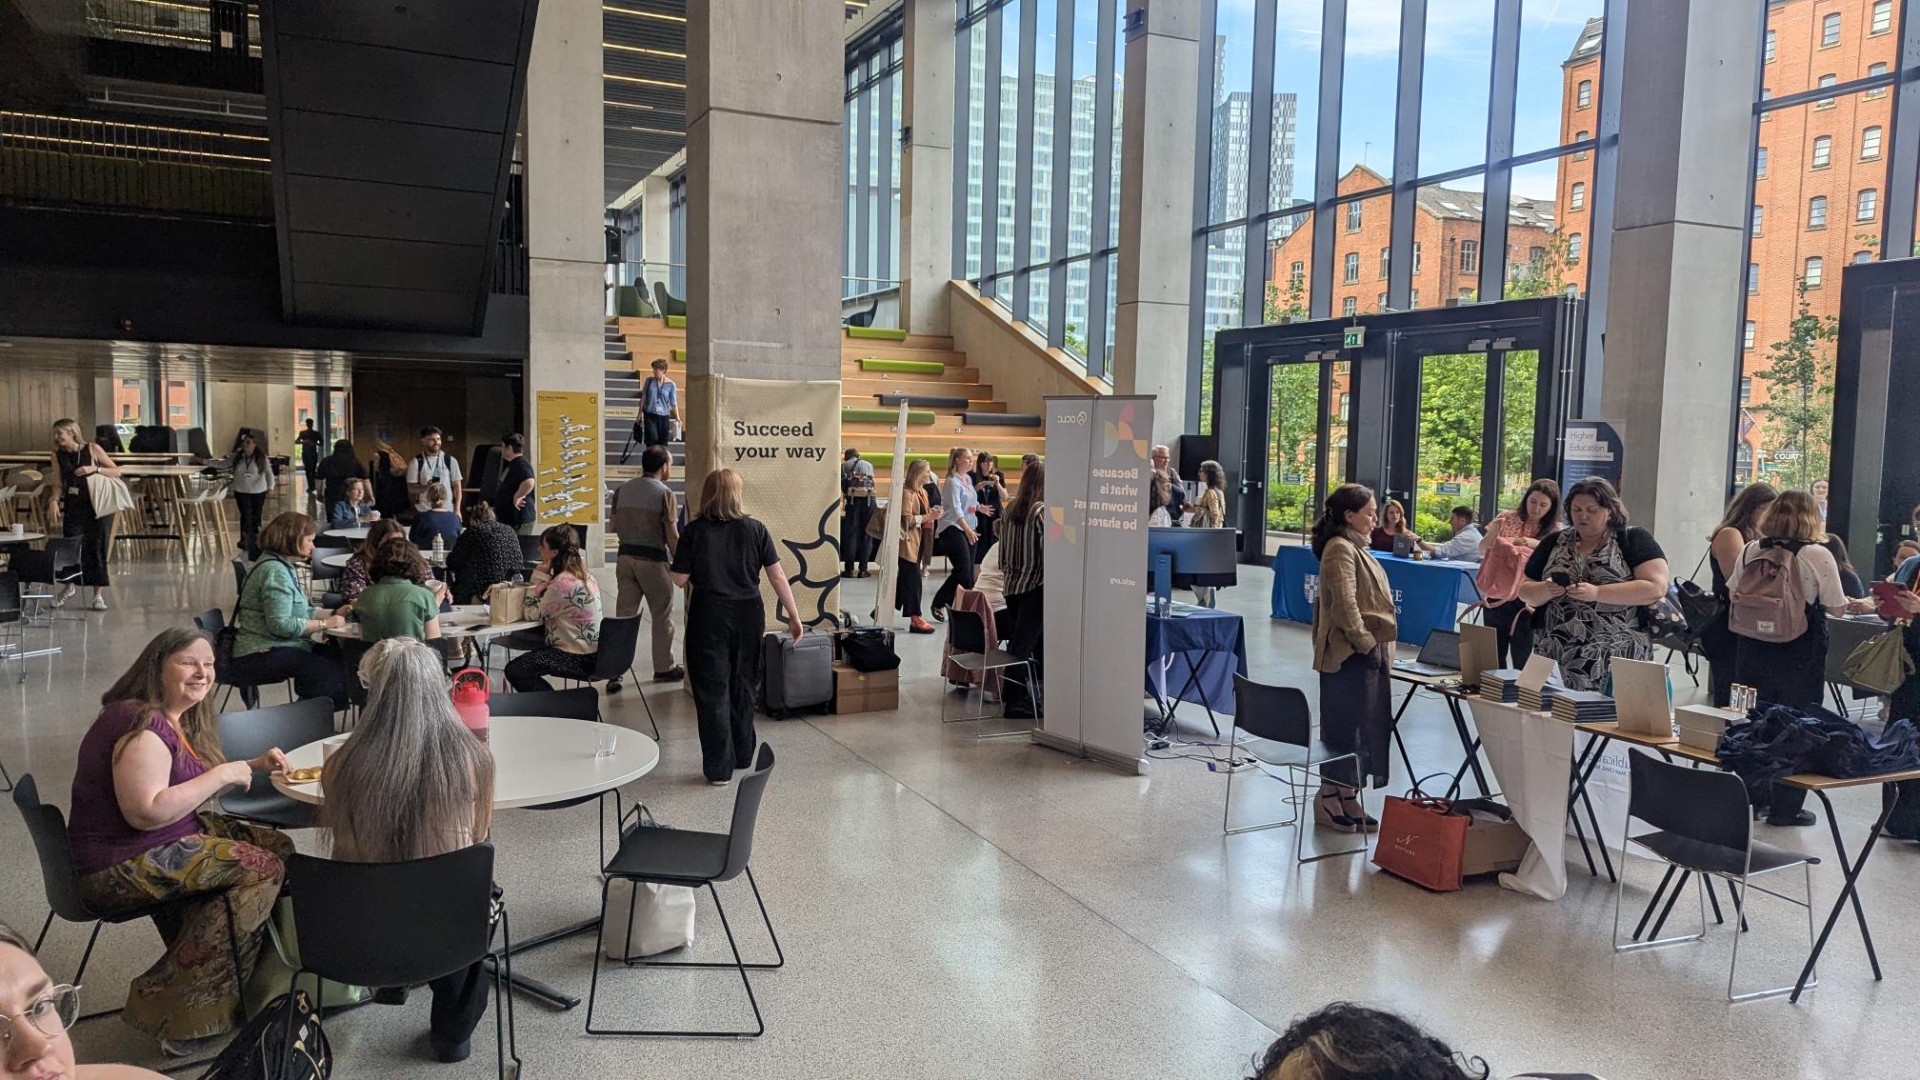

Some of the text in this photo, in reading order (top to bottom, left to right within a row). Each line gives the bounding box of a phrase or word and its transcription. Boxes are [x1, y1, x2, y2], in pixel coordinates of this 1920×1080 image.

[733, 420, 814, 437] Succeed
[1570, 432, 1594, 441] Higher
[734, 446, 827, 462] your way
[1570, 444, 1604, 452] Education
